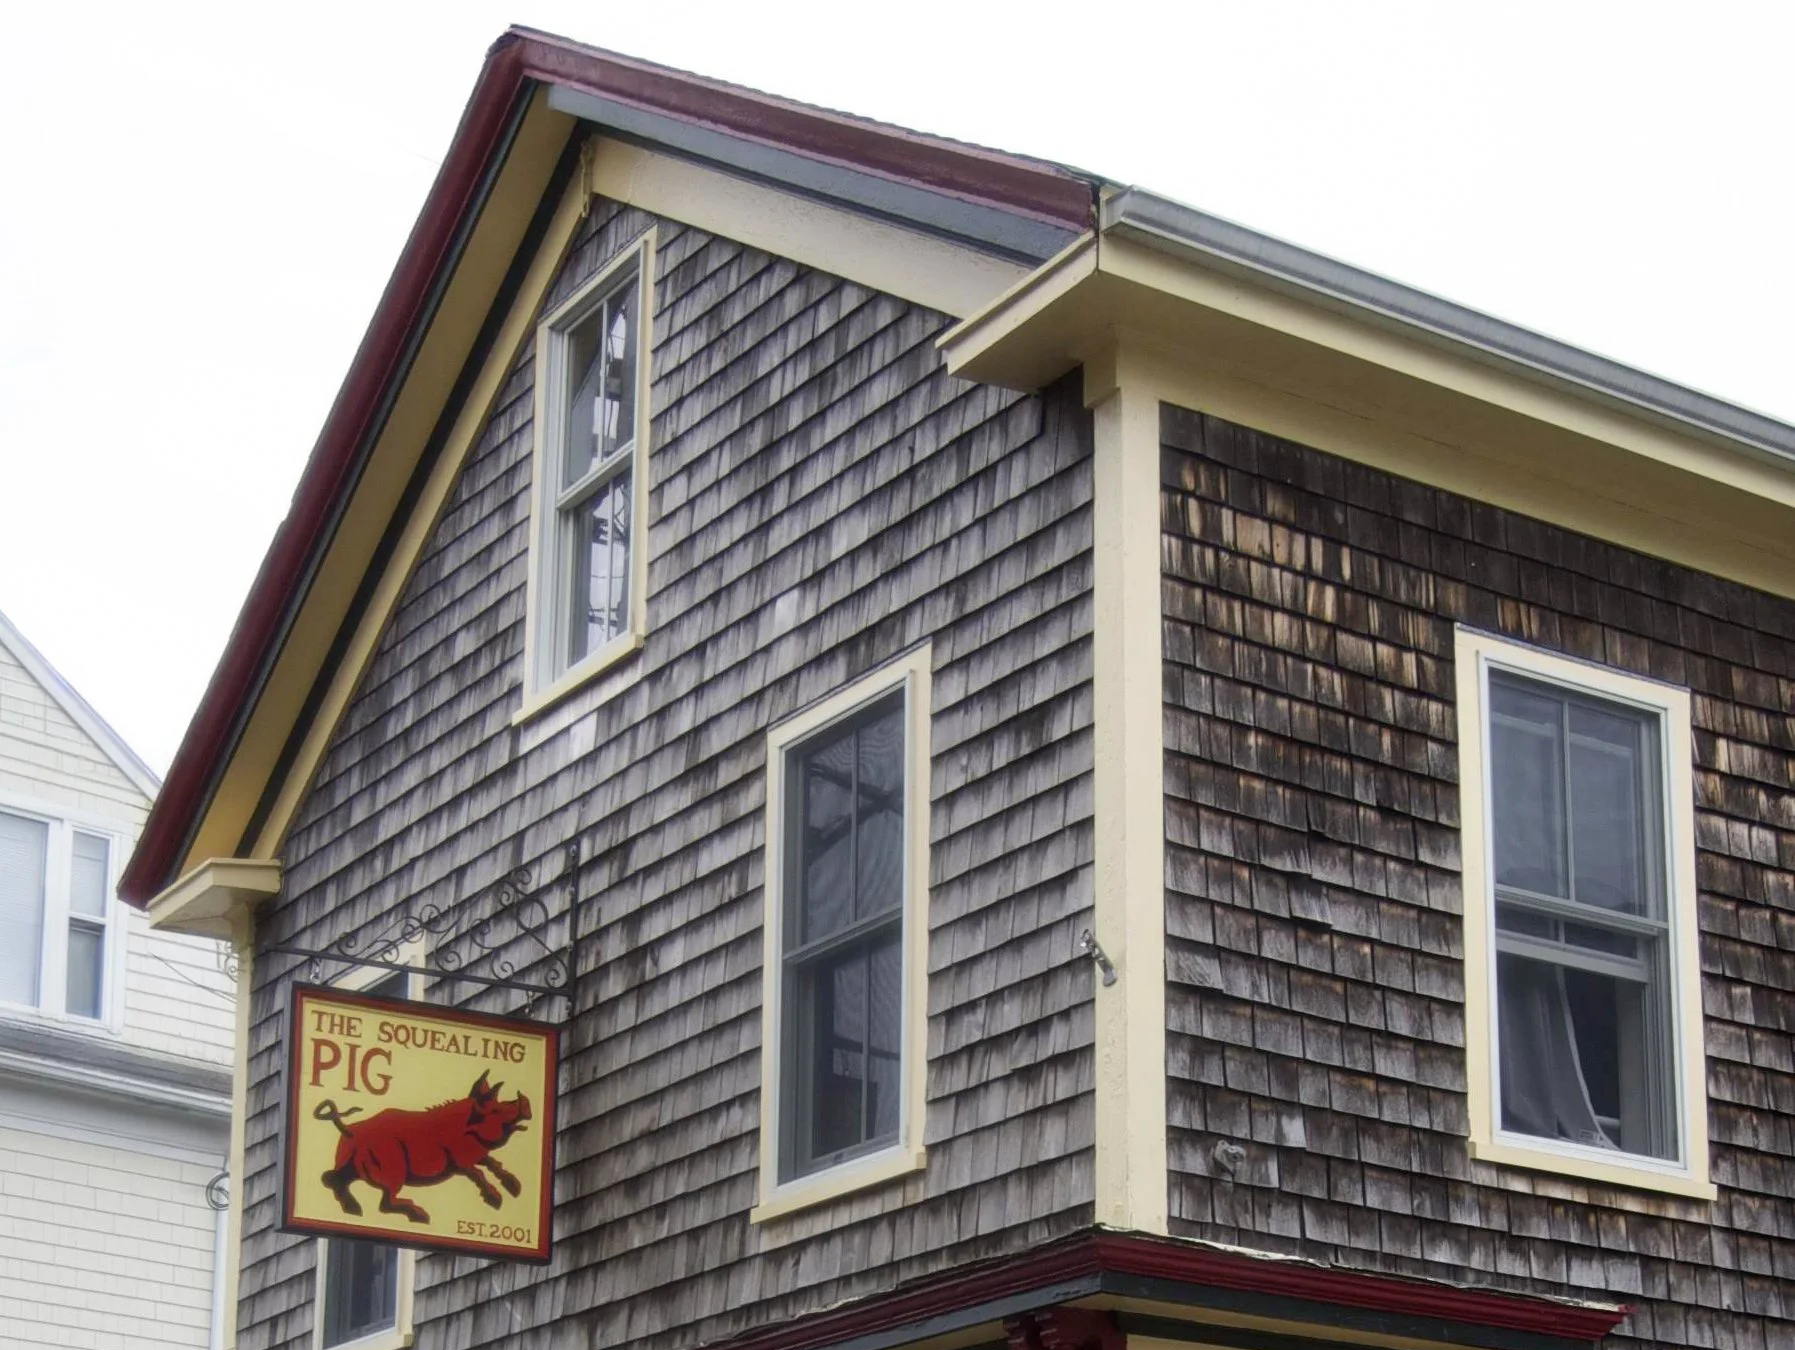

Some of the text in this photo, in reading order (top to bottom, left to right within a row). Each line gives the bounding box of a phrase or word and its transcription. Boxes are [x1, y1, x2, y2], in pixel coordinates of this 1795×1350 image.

[310, 1010, 526, 1064] THE SQUEALING
[309, 1037, 394, 1096] PIG
